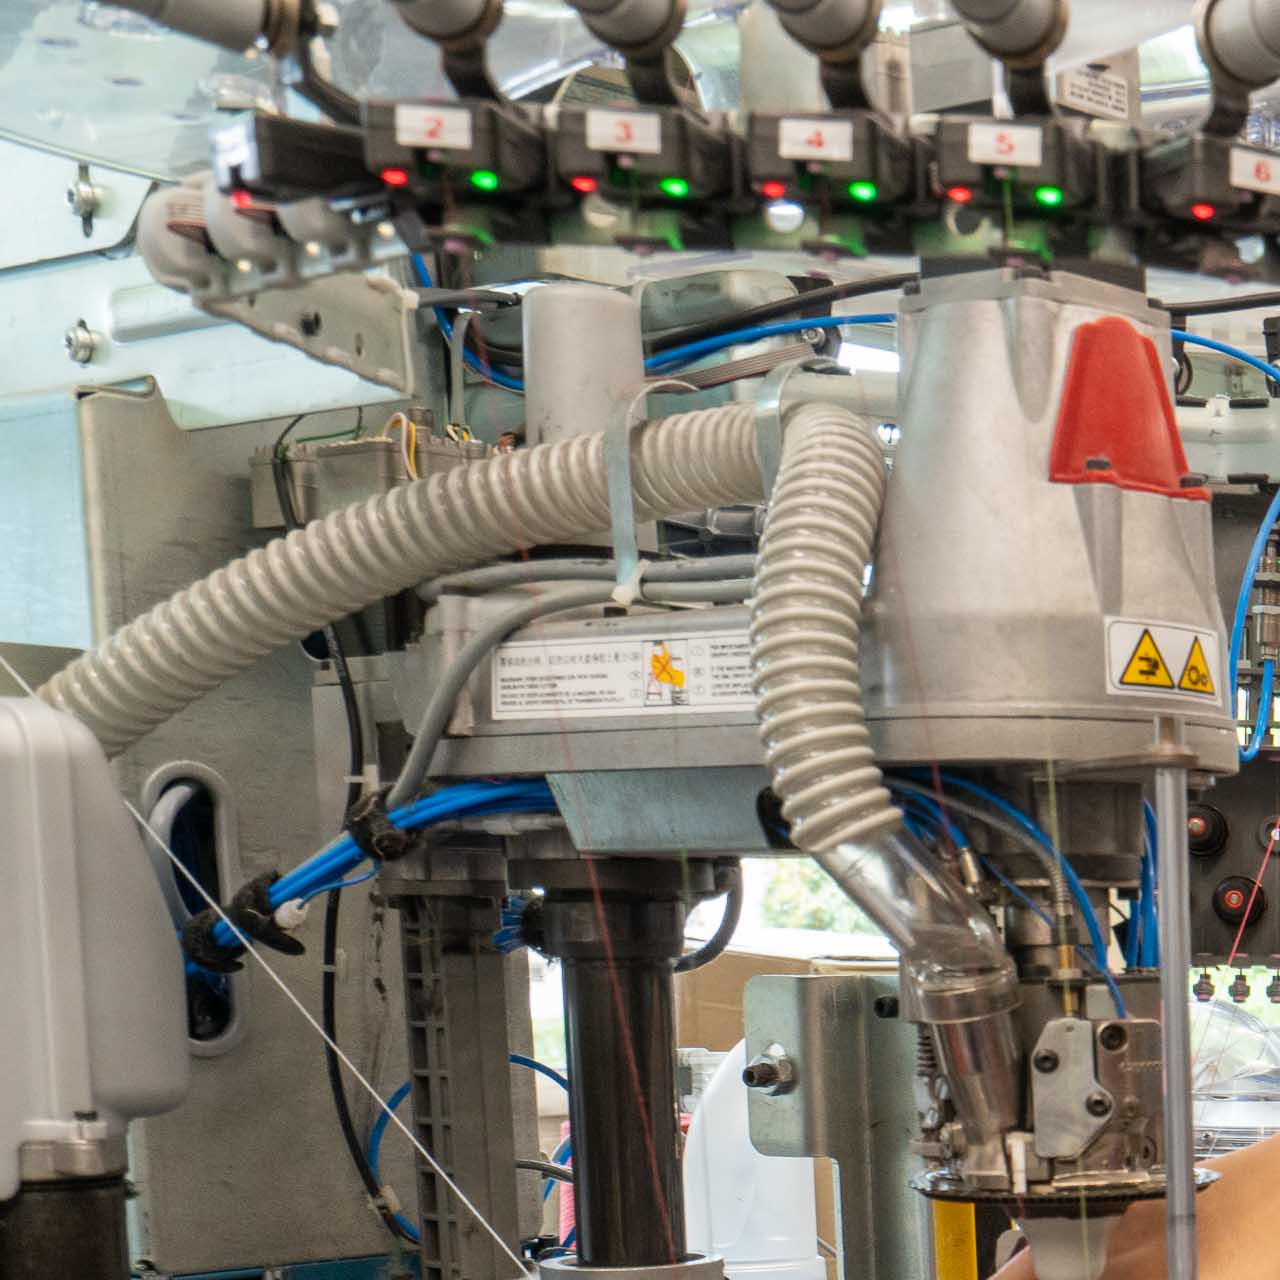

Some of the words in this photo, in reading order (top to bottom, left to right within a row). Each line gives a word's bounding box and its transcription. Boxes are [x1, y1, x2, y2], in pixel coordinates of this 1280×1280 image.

[425, 117, 444, 138] 2
[616, 122, 632, 144] 3
[805, 129, 824, 149] 4
[996, 132, 1014, 155] 5
[1254, 160, 1271, 182] 6
